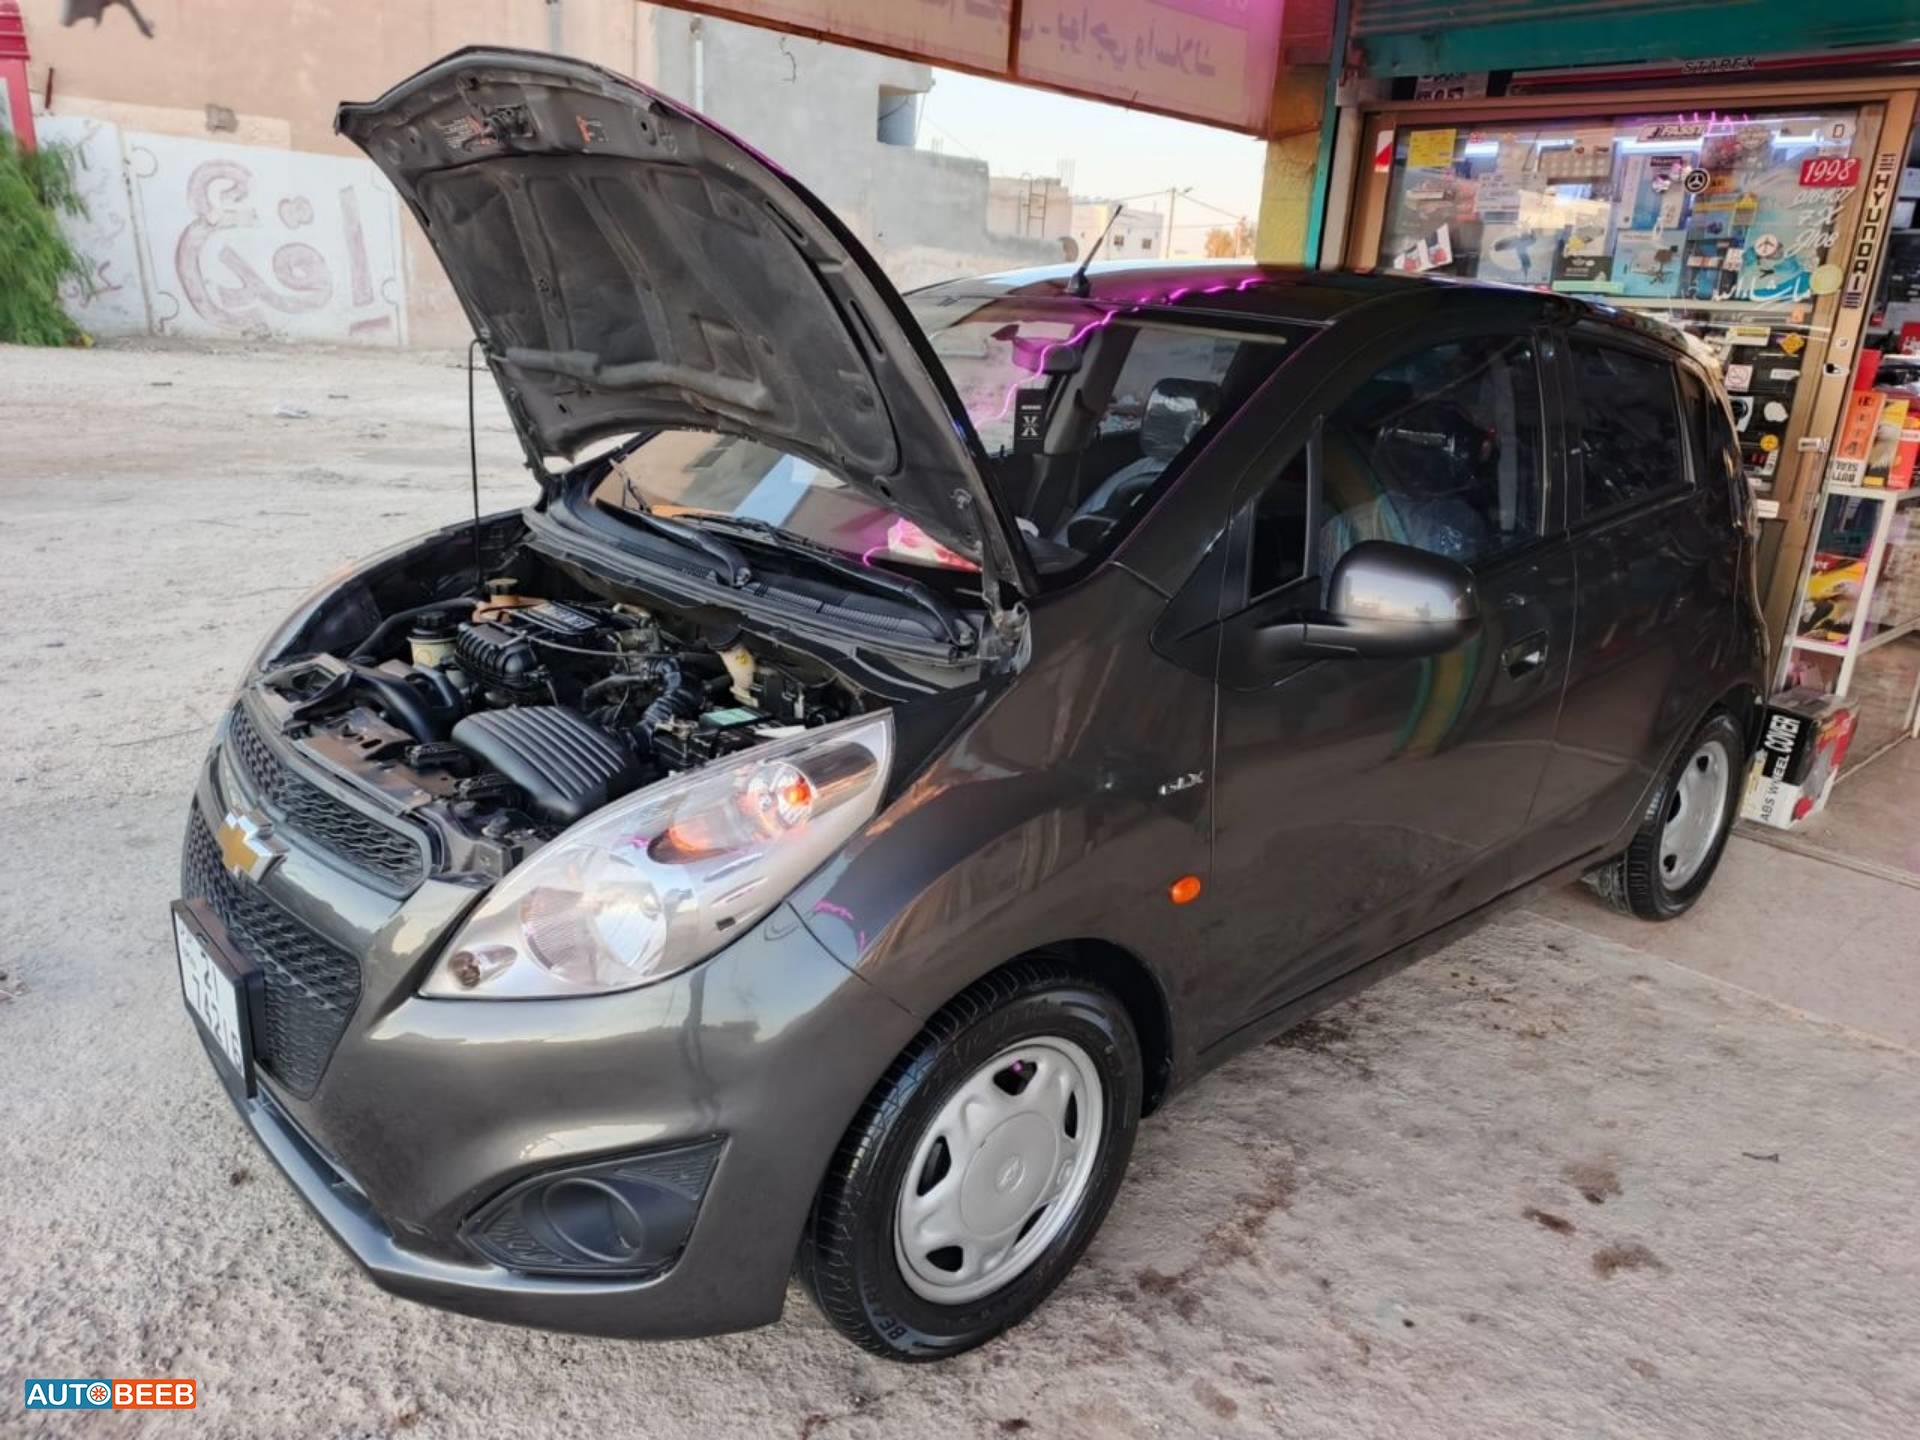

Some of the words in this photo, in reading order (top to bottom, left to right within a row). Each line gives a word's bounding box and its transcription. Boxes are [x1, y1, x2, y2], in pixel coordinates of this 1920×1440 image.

[1803, 158, 1856, 183] 1998
[1852, 173, 1891, 290] HYUNDAI
[1764, 715, 1801, 753] COVER
[1768, 755, 1790, 795] WHEEL
[1761, 797, 1775, 821] ABS
